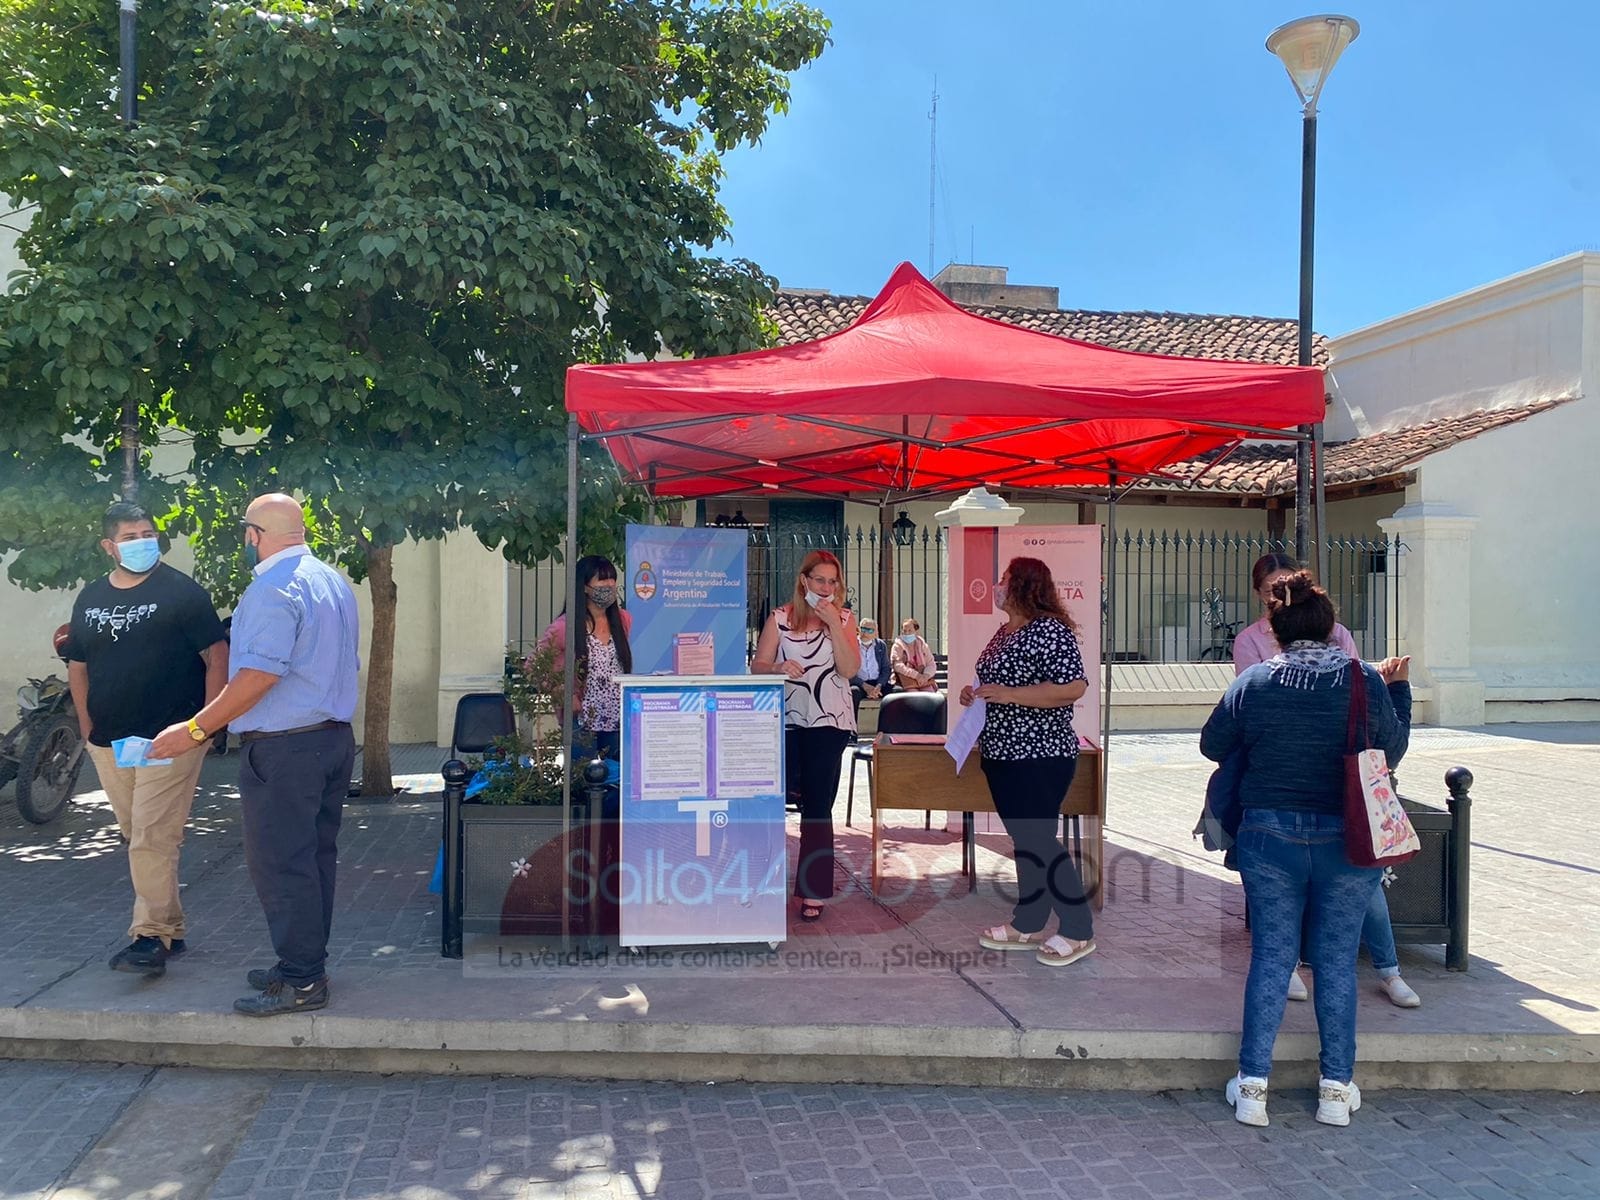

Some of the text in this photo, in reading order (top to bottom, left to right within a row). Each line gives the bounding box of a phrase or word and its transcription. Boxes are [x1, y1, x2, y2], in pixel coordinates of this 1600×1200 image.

[662, 569, 694, 577] Ministerio
[662, 578, 686, 587] Empleo
[693, 578, 723, 588] Seguridad
[723, 579, 740, 587] Social
[662, 588, 708, 600] Argentina
[1057, 587, 1084, 600] LTA
